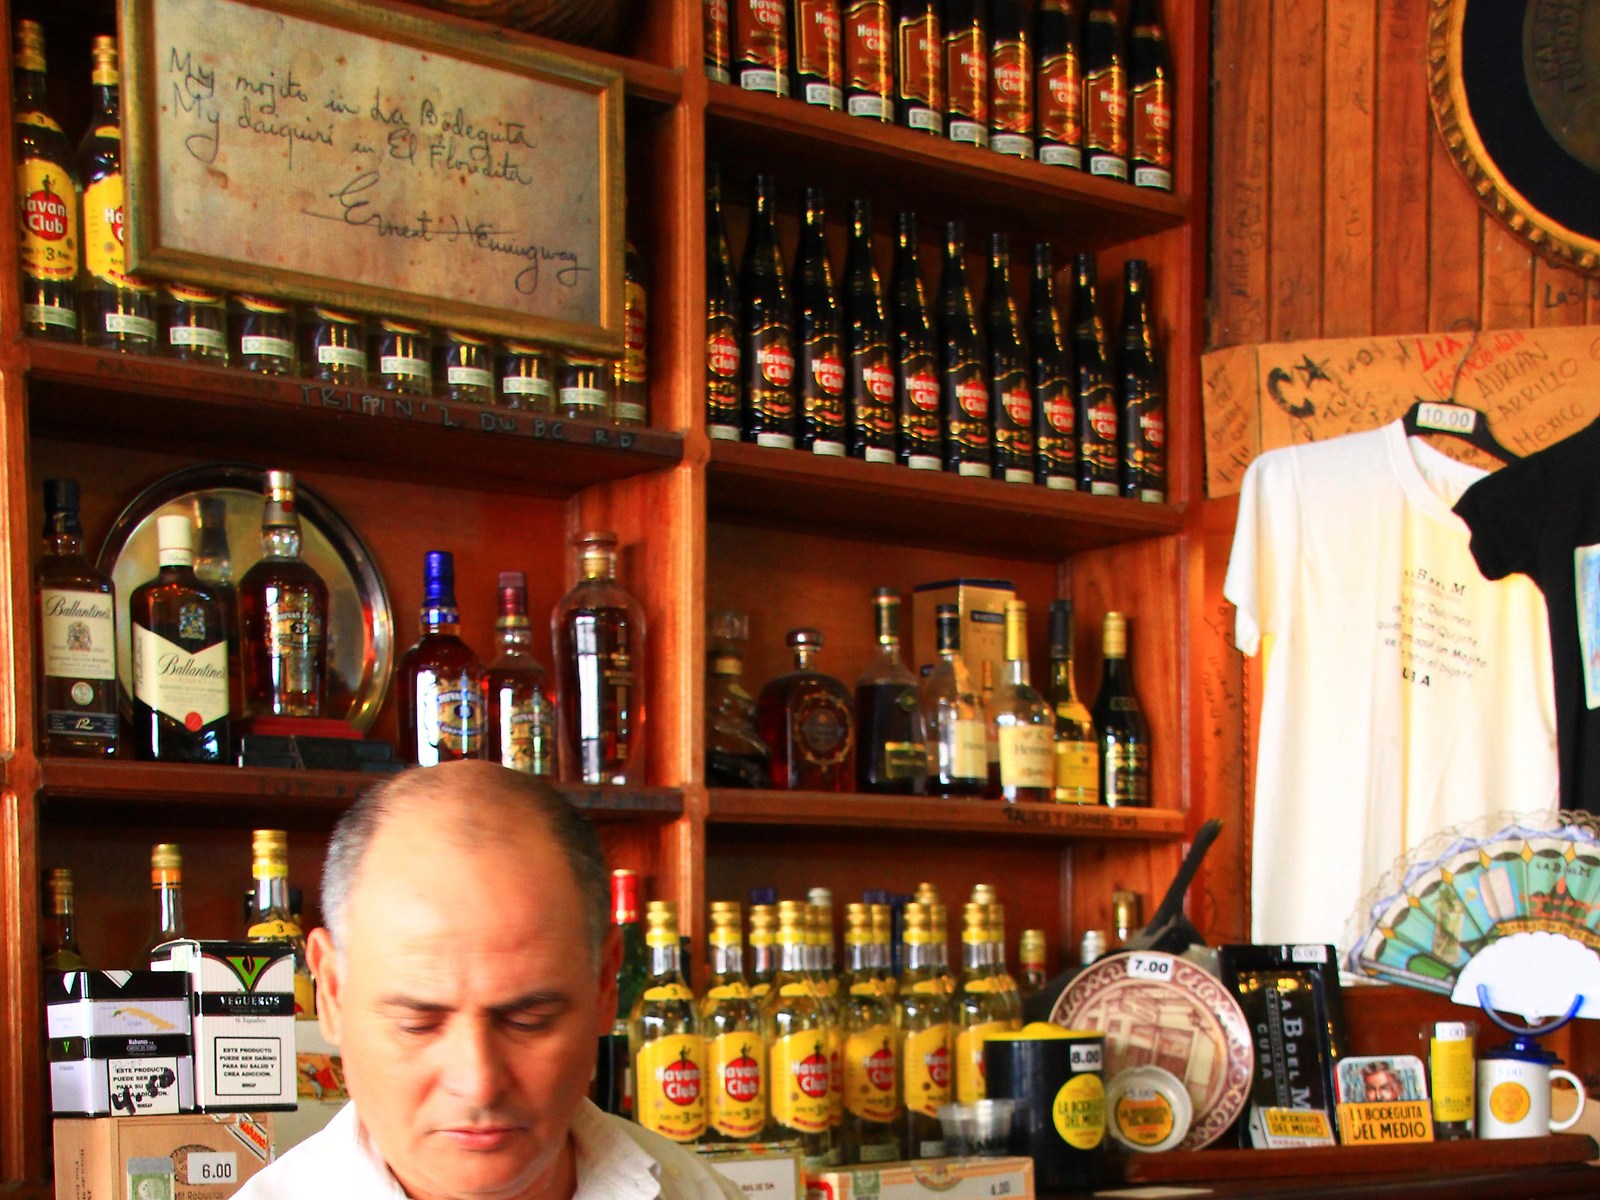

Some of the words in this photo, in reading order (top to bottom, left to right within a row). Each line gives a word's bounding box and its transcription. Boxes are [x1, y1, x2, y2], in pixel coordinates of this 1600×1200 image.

[170, 47, 214, 99] My
[236, 69, 307, 114] mojito
[325, 91, 360, 114] in
[421, 98, 538, 160] Bodeguita
[174, 82, 219, 164] My
[238, 96, 334, 170] daiquiri
[352, 136, 375, 154] in
[388, 128, 418, 165] El
[329, 172, 433, 242] Ernest
[28, 214, 64, 235] Club
[1474, 341, 1549, 399] ADRIAN
[1424, 407, 1470, 428] 10.00
[46, 595, 111, 620] Ballantine's
[1134, 958, 1169, 974] 7.00
[219, 996, 281, 1007] VEGUEROS
[1071, 1051, 1100, 1064] 8.00
[1256, 1022, 1273, 1080] CUBA
[665, 1083, 698, 1099] Club
[726, 1079, 757, 1095] Club
[1365, 1106, 1423, 1119] BODEGUITA
[1380, 1120, 1426, 1138] MEDIO
[202, 1163, 232, 1179] 6.00
